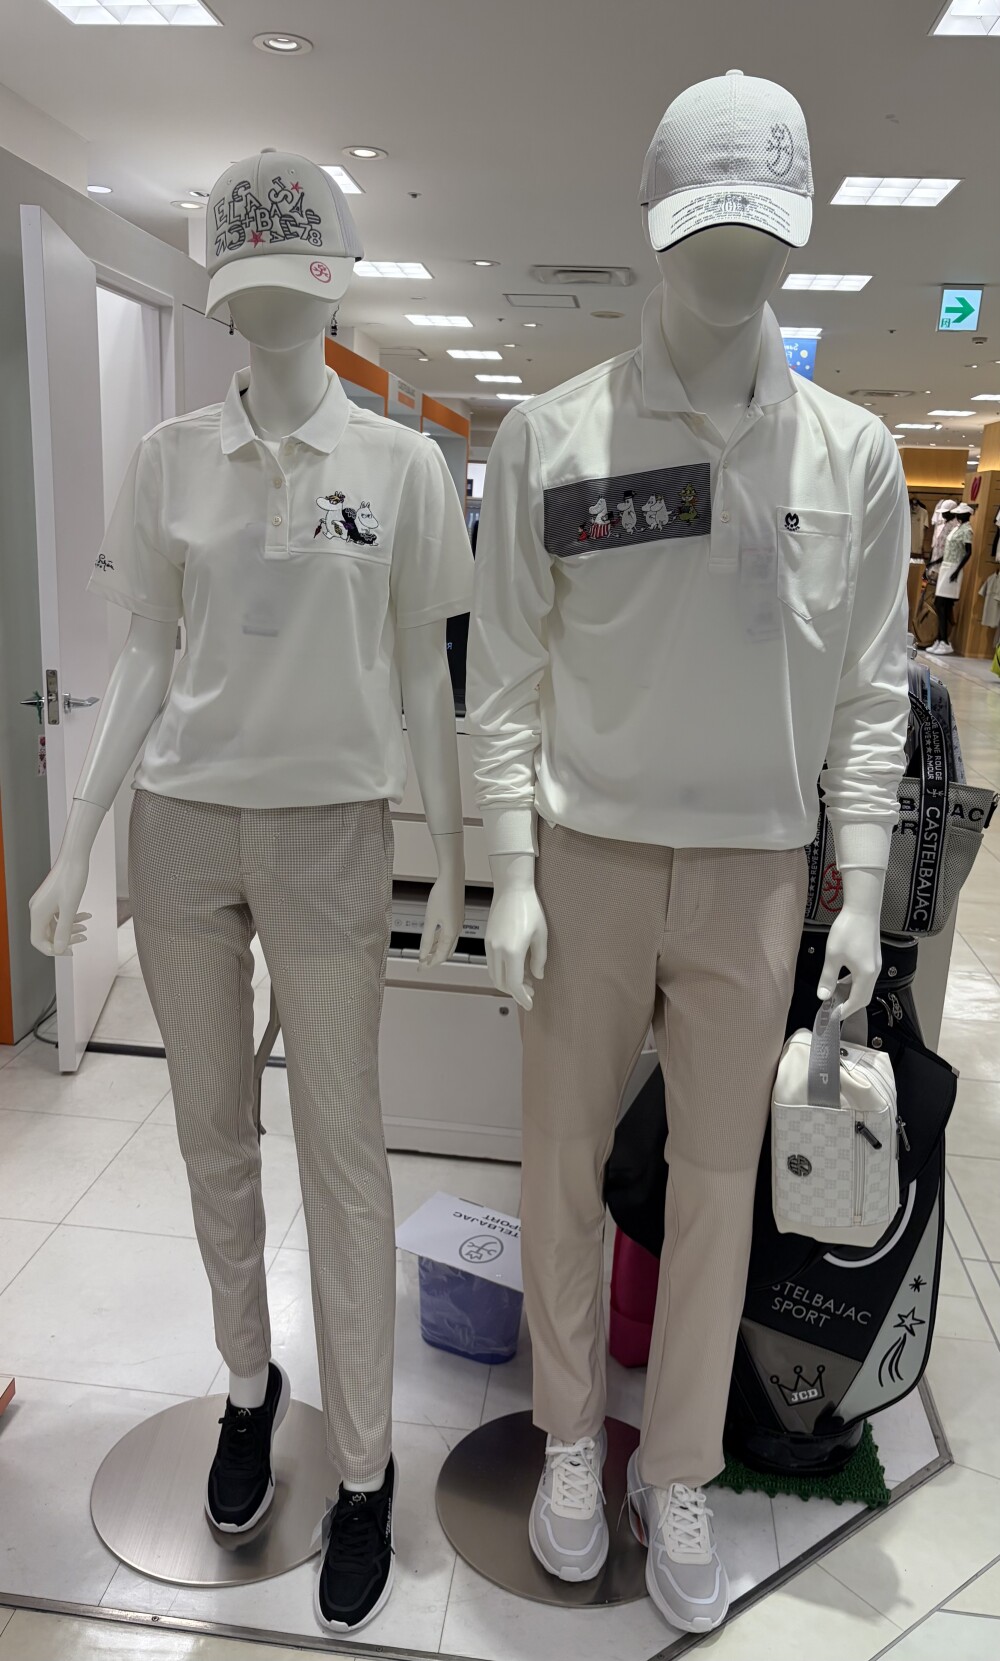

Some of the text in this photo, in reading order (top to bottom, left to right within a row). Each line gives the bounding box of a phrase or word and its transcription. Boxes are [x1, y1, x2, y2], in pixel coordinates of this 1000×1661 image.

[932, 731, 941, 754] JAUNE
[926, 754, 935, 780] AMOUR
[934, 755, 942, 780] ROUGE
[913, 806, 941, 921] CASTELBAJAC
[771, 1296, 831, 1328] SPORT
